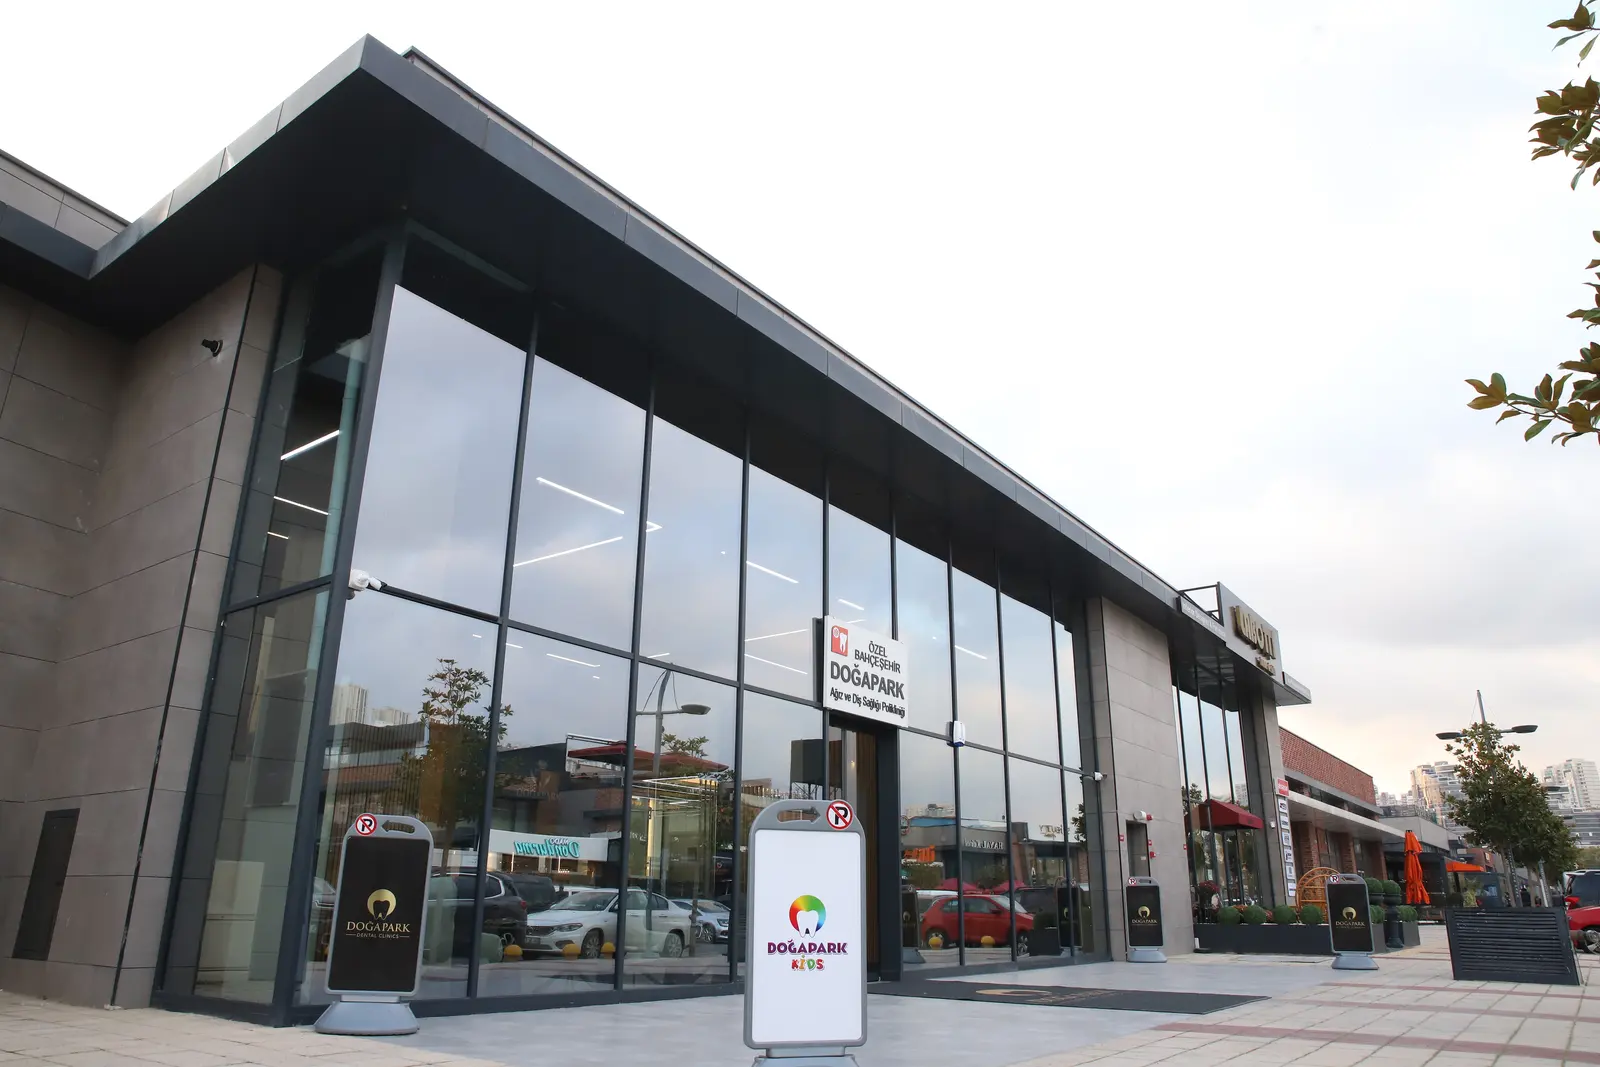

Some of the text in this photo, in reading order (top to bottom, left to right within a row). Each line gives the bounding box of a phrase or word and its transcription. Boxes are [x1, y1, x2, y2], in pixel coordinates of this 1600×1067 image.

[869, 641, 887, 657] ÖZEL
[855, 649, 900, 673] BAHÇEŞEHİR
[830, 661, 905, 700] DOĞAPARK
[830, 687, 843, 701] Ağız
[844, 692, 852, 702] ve
[852, 693, 862, 708] Diş
[346, 920, 411, 933] DOĞAPARK
[767, 939, 848, 955] DOĞAPARK
